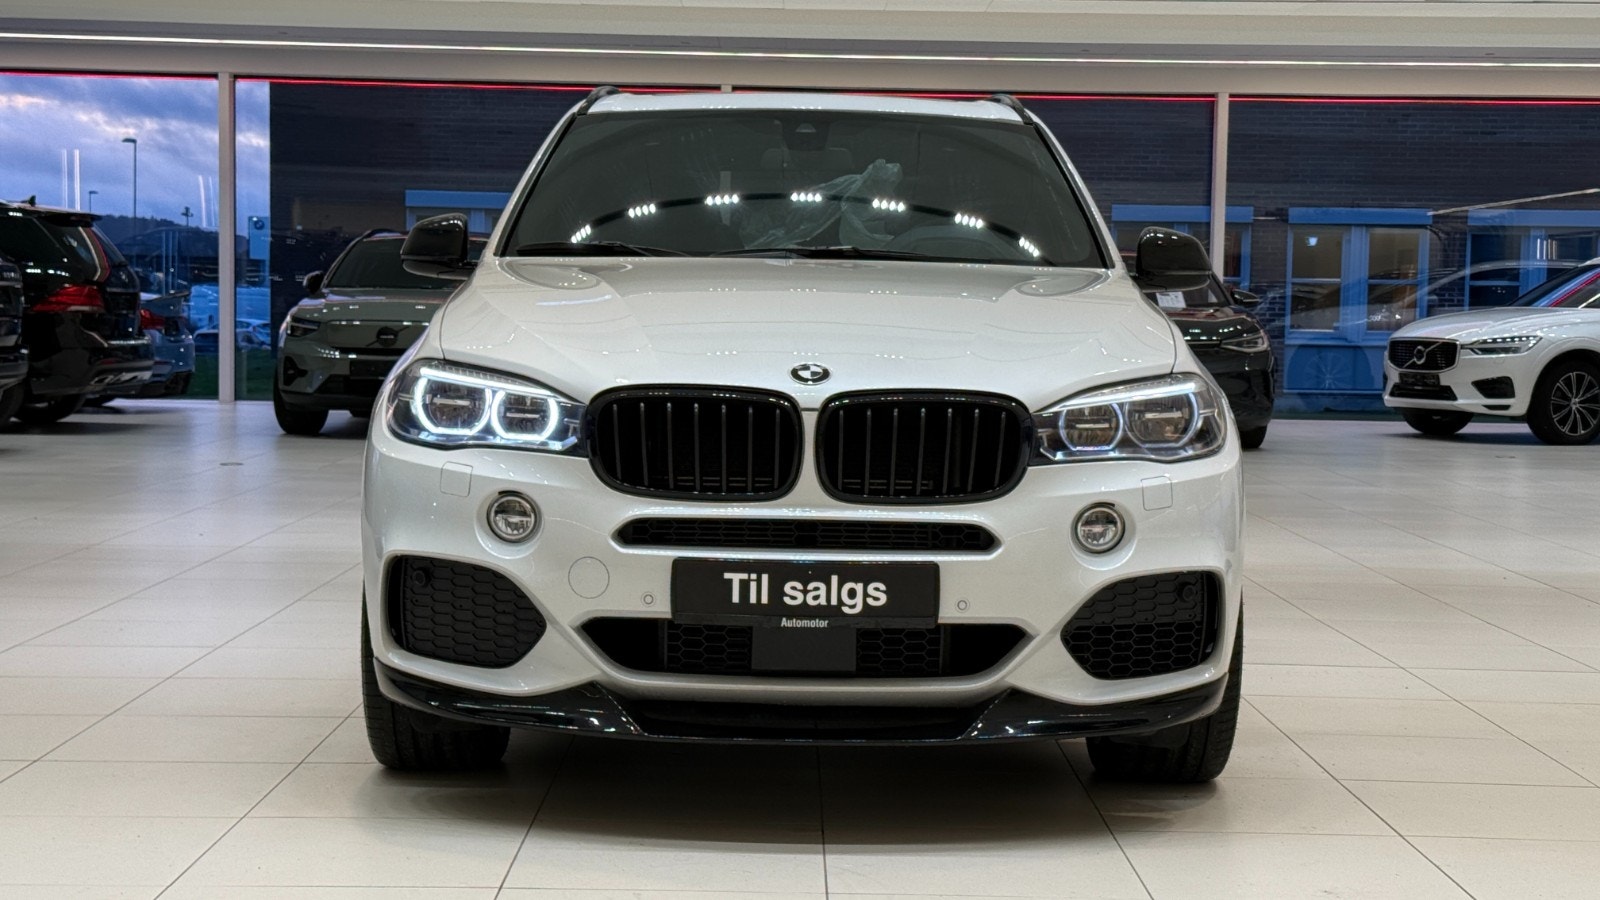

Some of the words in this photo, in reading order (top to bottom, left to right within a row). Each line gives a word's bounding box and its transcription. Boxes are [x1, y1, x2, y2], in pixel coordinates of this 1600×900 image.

[723, 572, 769, 605] Til
[783, 574, 888, 615] salgs
[780, 617, 829, 628] Automotor
